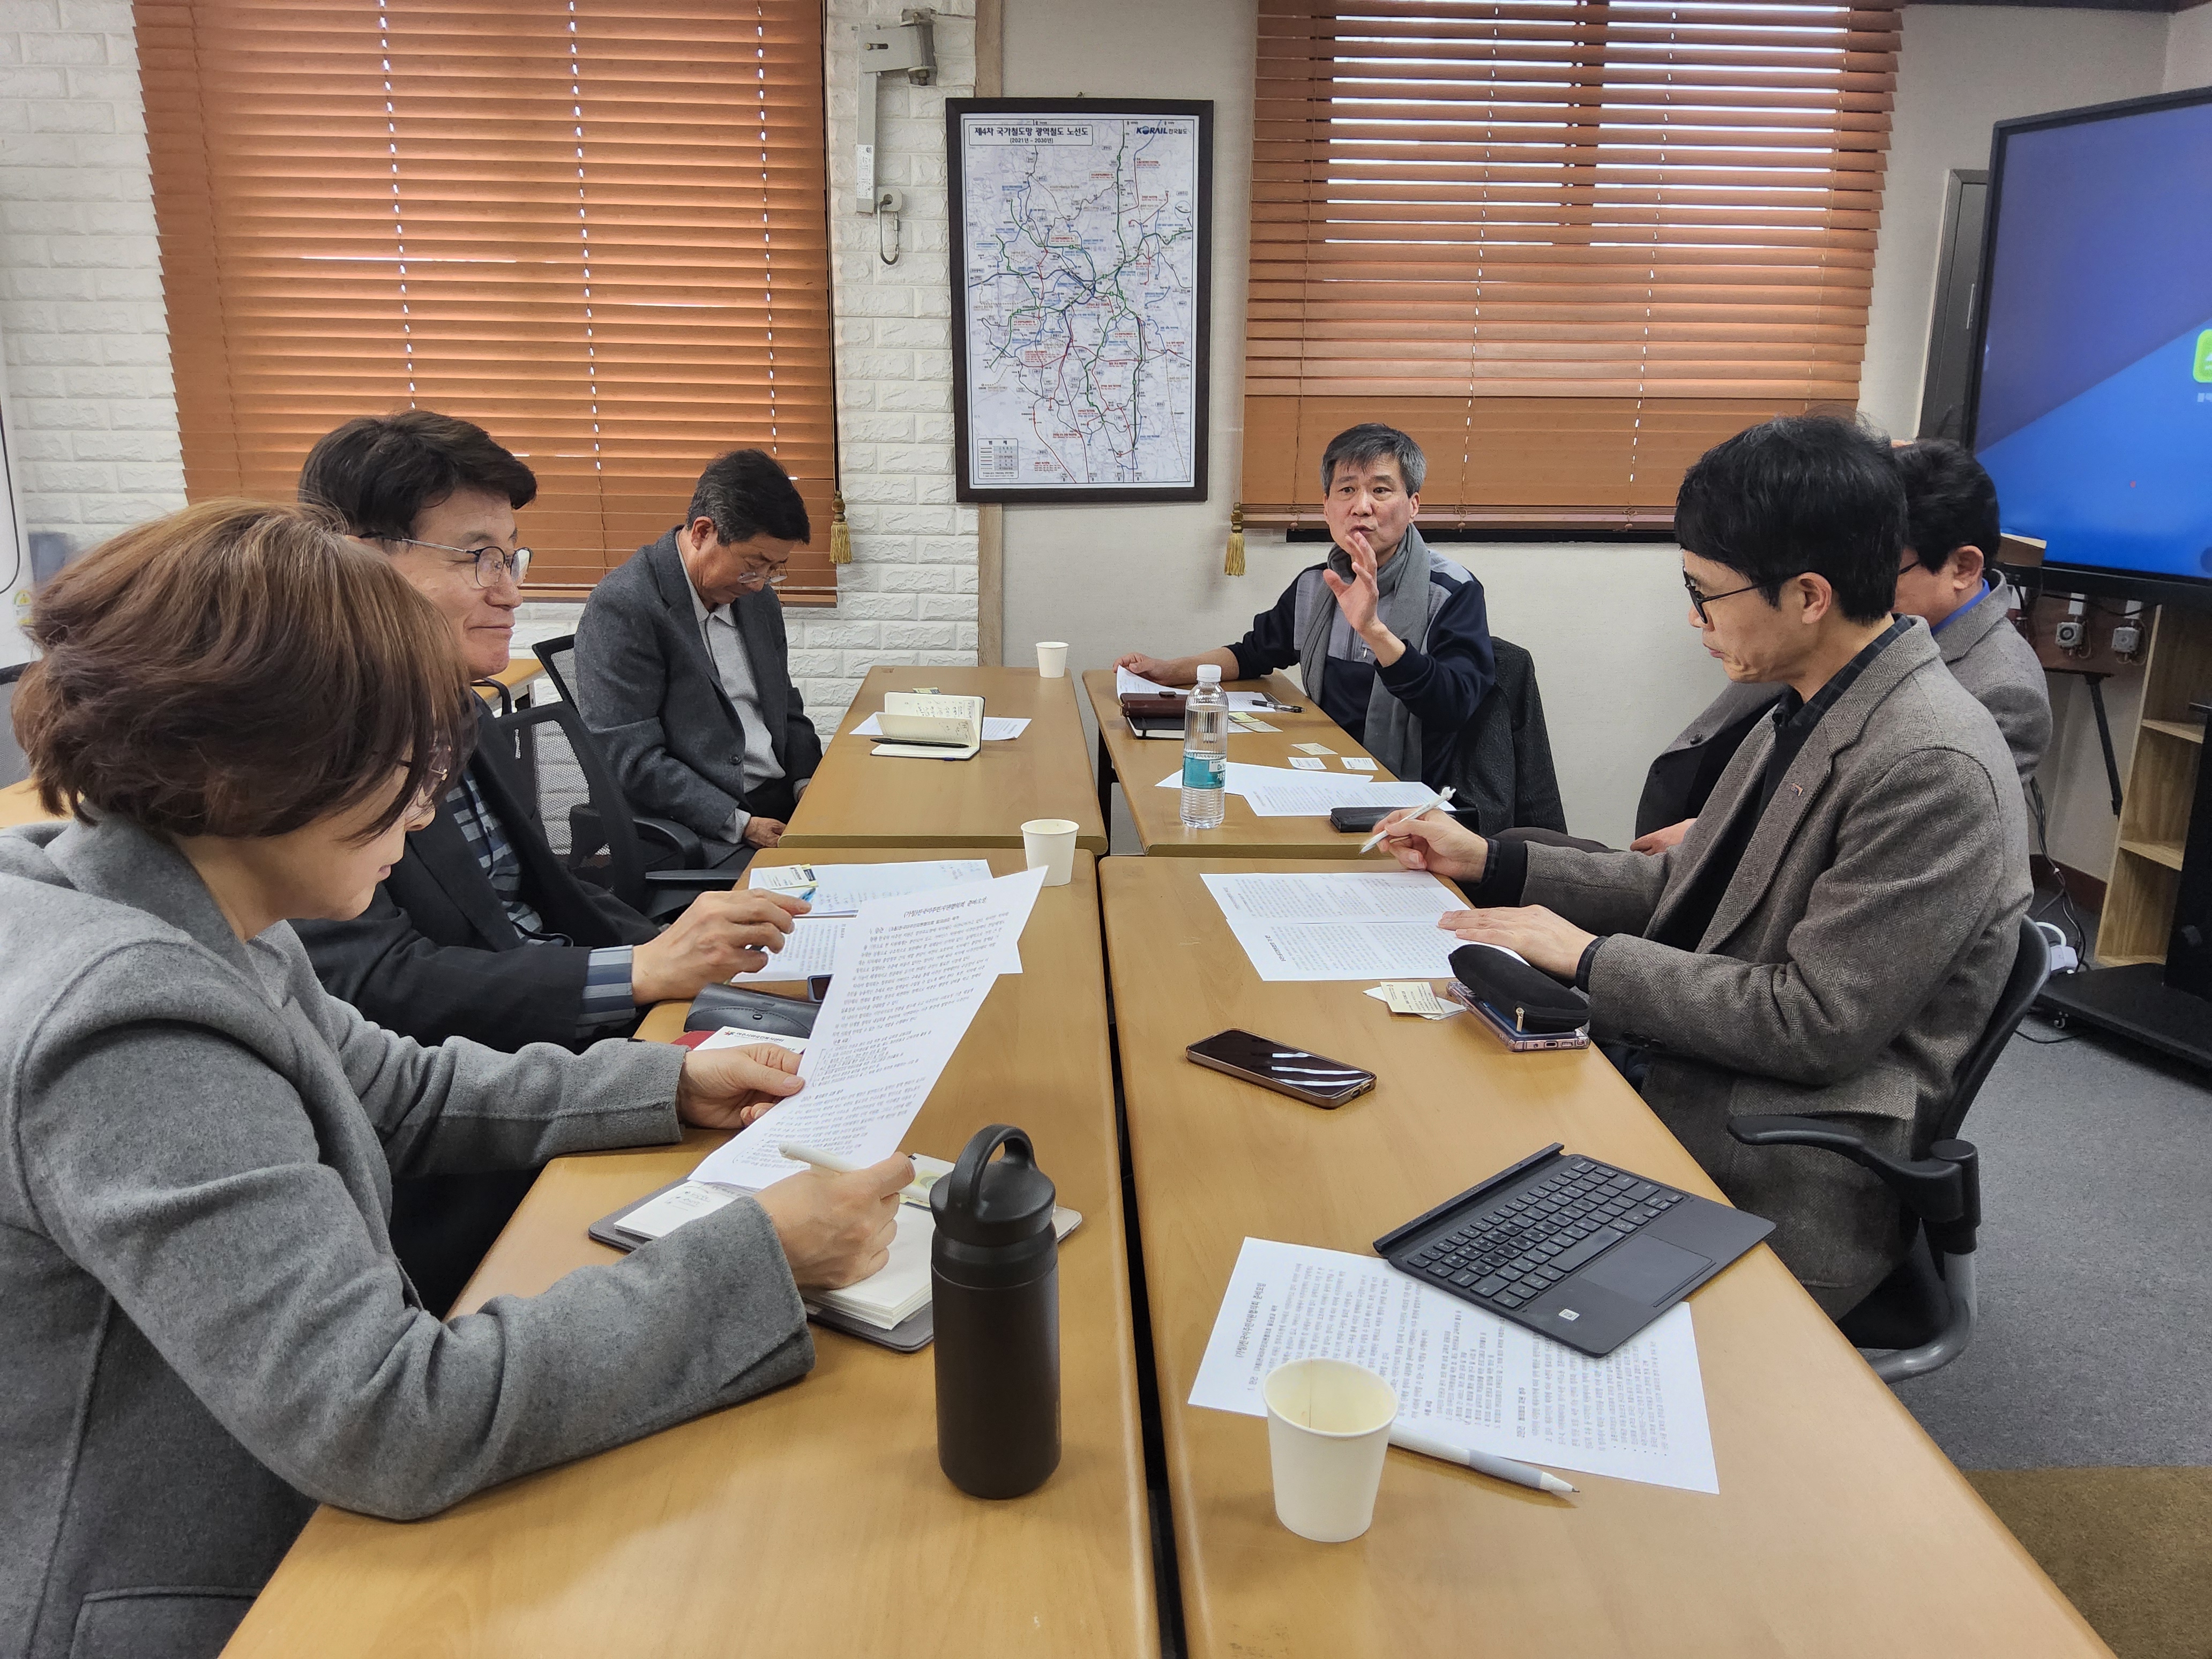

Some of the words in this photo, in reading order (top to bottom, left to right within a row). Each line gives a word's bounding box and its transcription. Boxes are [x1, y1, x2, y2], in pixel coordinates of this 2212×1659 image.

[975, 127, 993, 136] 제4차
[997, 127, 1033, 136] 국가철도망
[1036, 127, 1064, 136] 광역철도
[1067, 127, 1088, 136] 노선도
[1136, 125, 1168, 134] KORAIL
[1236, 1301, 1258, 1357] (가칭)전국이주민지원협의회
[1253, 1282, 1266, 1299] 준비모임
